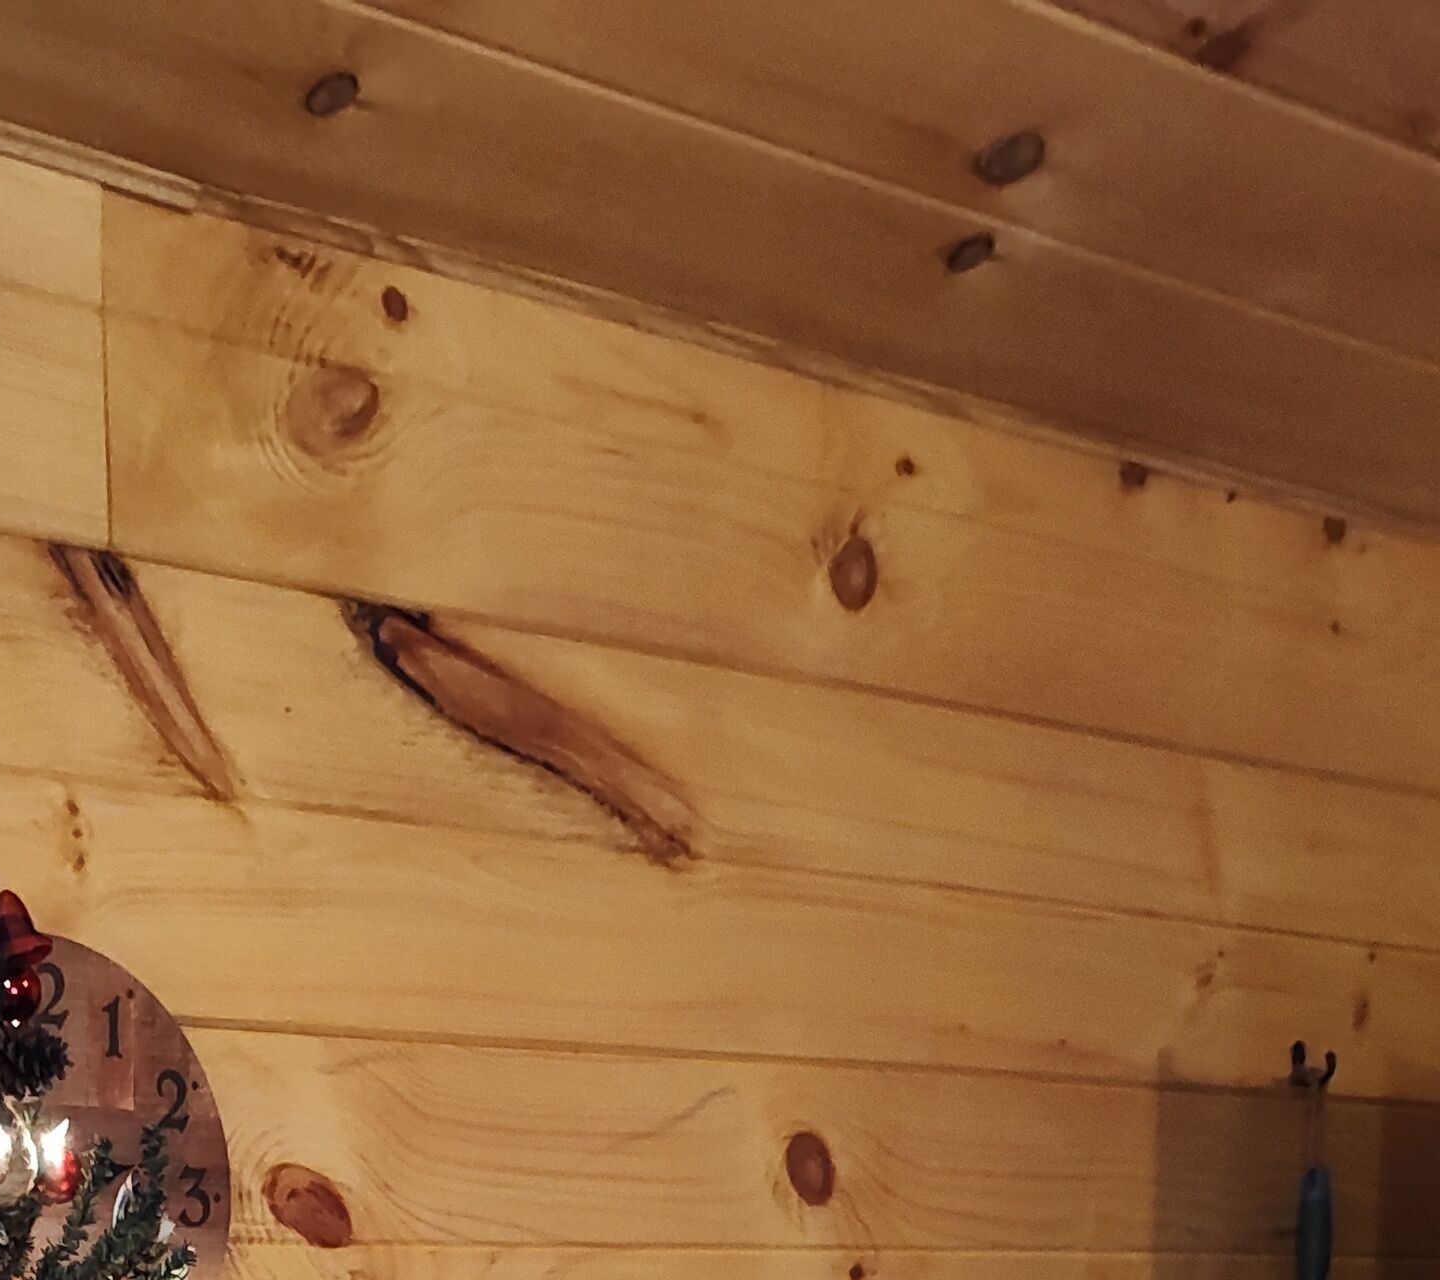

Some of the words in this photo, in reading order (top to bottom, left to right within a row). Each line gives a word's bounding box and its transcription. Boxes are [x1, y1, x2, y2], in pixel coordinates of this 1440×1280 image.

[101, 995, 124, 1059] 1
[156, 1070, 190, 1133] 2
[178, 1166, 211, 1228] 3
